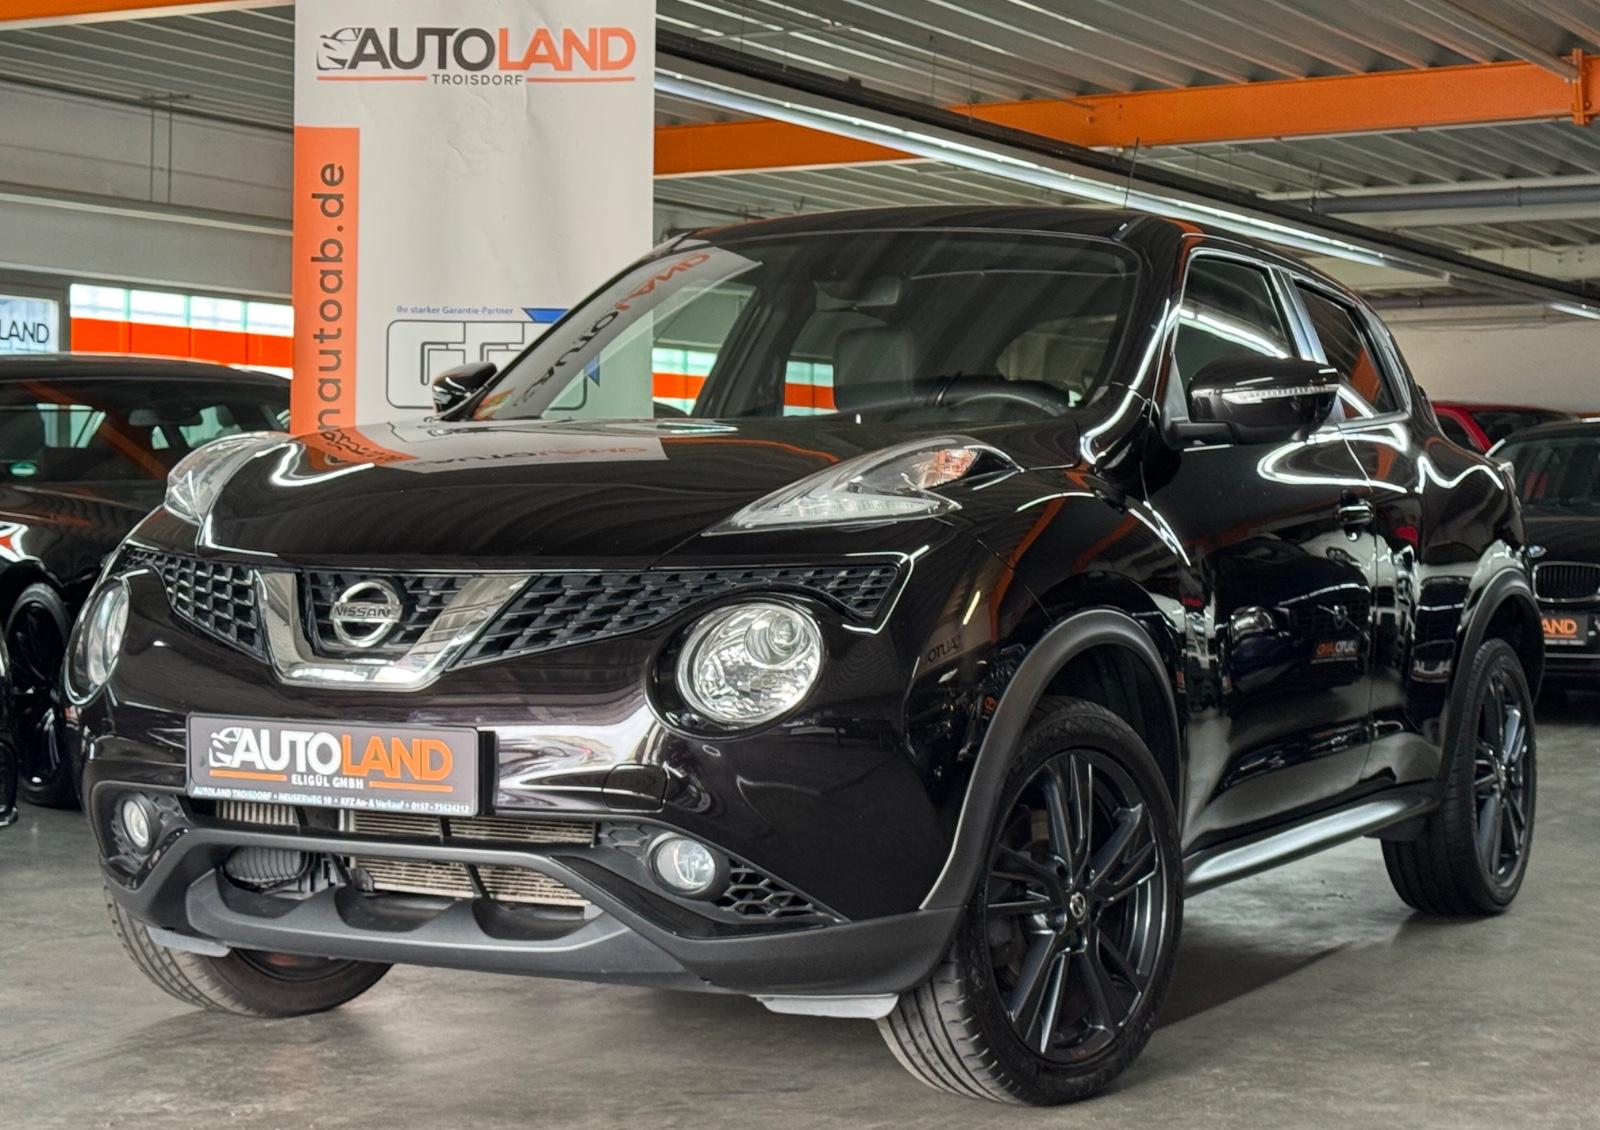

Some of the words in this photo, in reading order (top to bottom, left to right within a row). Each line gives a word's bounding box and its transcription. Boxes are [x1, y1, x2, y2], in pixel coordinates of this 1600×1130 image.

[347, 27, 636, 72] AUTOLAND
[431, 73, 523, 86] TROISDORF
[396, 305, 408, 313] Ihr
[411, 305, 440, 314] starker
[442, 305, 514, 315] Garantie-Partner
[334, 606, 391, 618] NISSAN
[231, 727, 454, 782] AUTOLAND
[291, 773, 330, 788] ELIGÜL
[332, 778, 364, 790] GMBH
[193, 786, 232, 798] AUTOLAND
